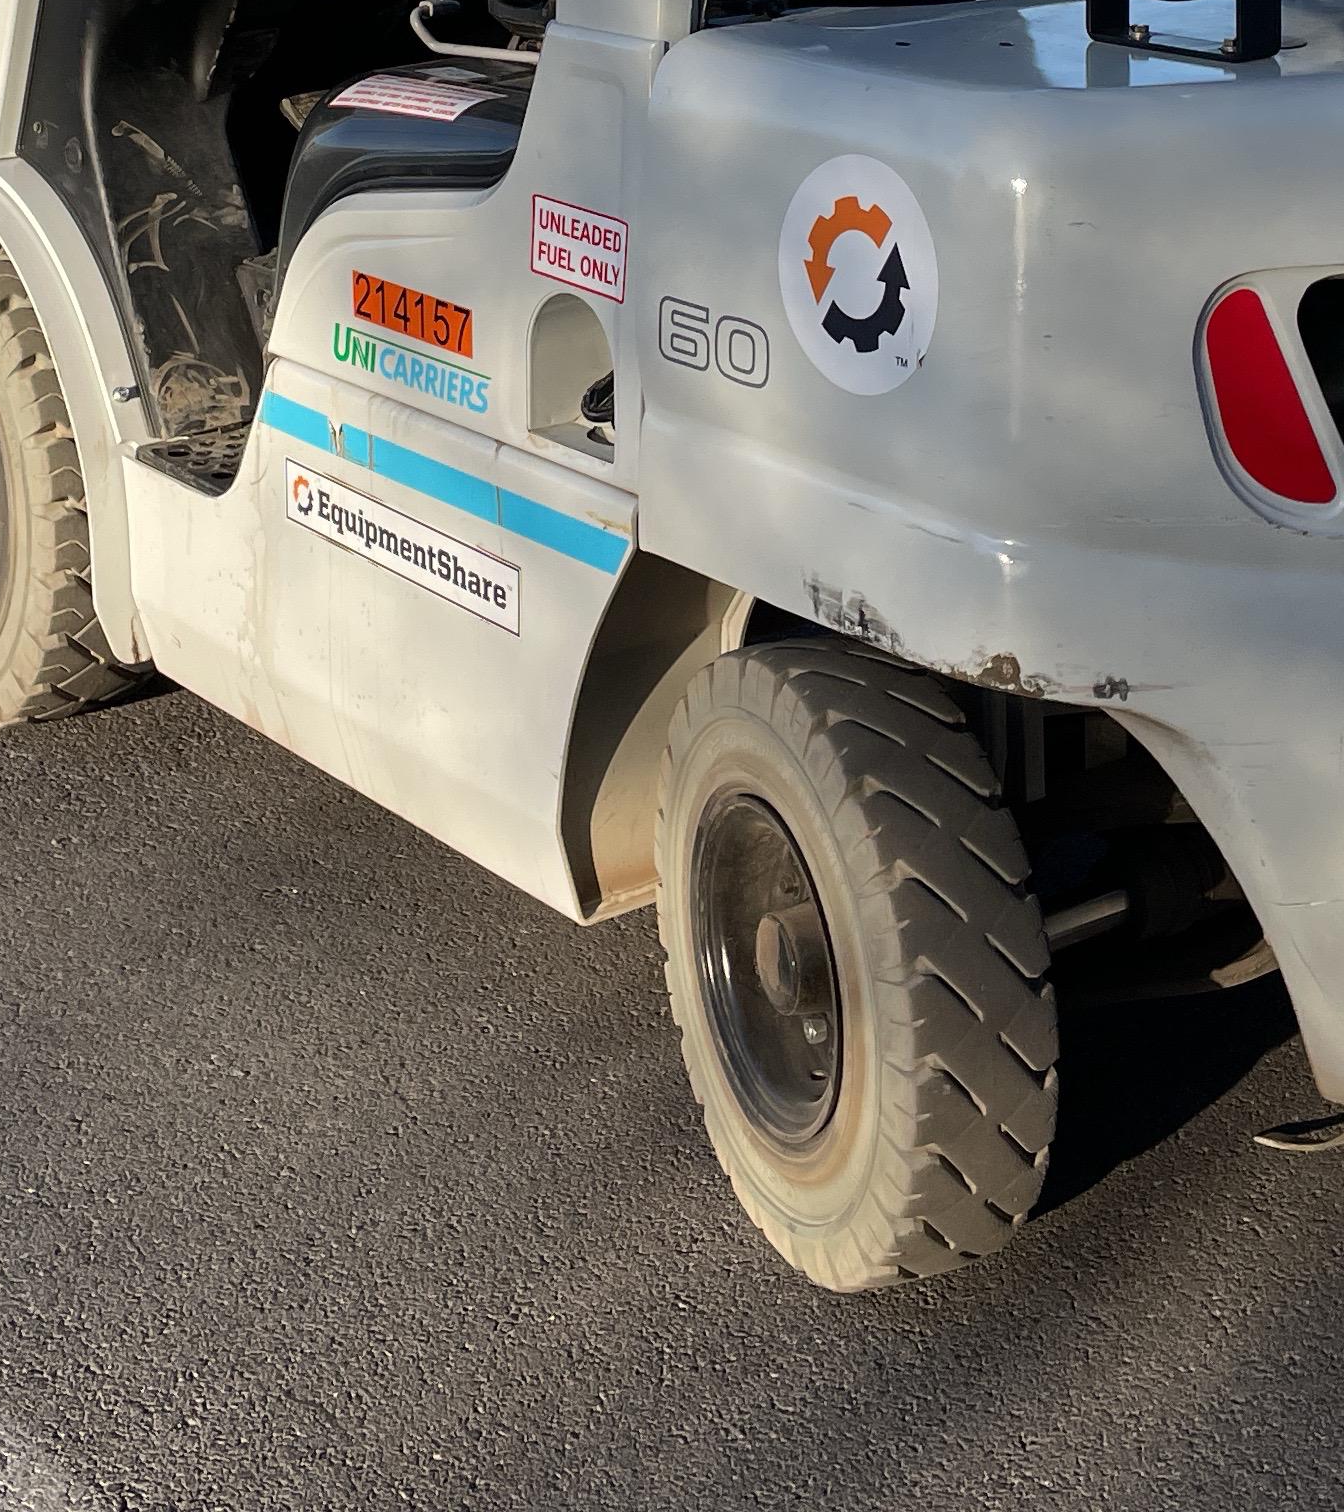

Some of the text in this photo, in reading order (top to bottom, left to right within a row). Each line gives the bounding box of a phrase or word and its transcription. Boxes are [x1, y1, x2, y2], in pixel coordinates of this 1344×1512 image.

[538, 240, 621, 288] FUEL ONLY
[539, 207, 622, 254] UNLEADED
[355, 272, 473, 353] 214157
[658, 295, 770, 389] 60
[317, 489, 507, 610] EquipmentShare
